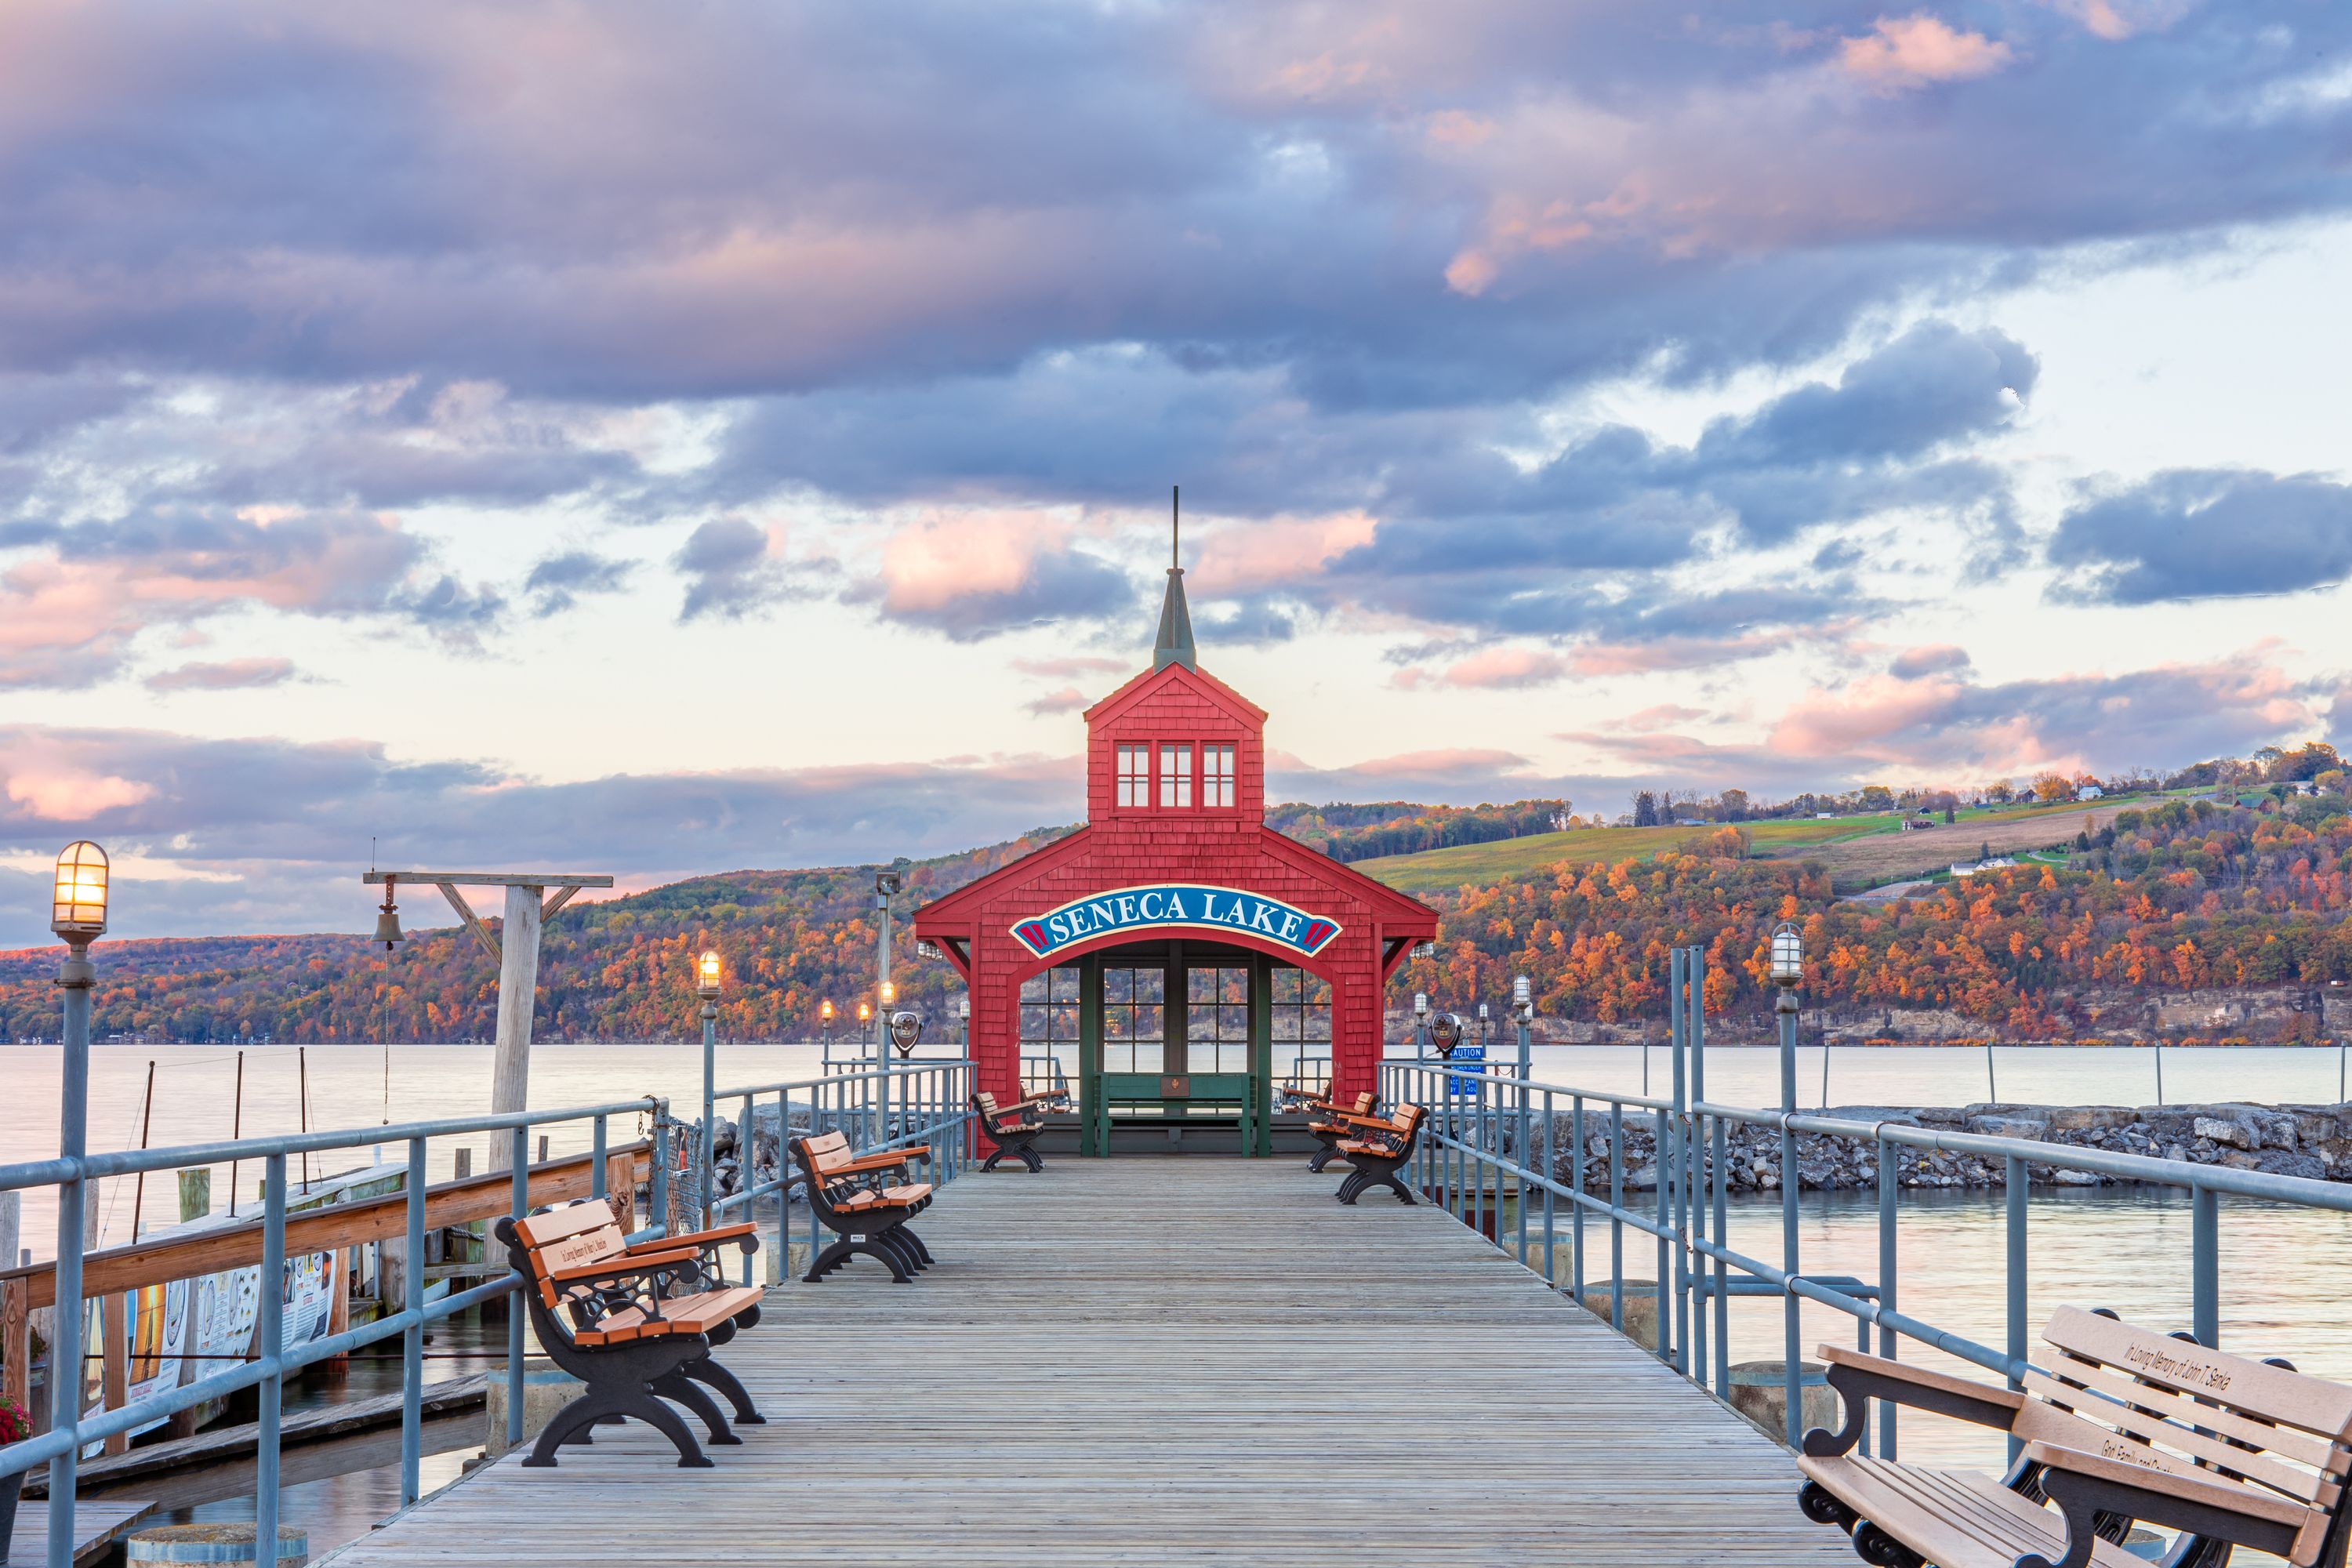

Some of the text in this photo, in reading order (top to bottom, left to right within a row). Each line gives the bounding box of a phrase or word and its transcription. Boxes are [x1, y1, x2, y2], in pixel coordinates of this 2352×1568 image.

[1049, 891, 1303, 944] SENECA LAKE
[1450, 1048, 1481, 1057] AUTION
[2124, 1341, 2231, 1391] In Loving Memory of John T. Senka
